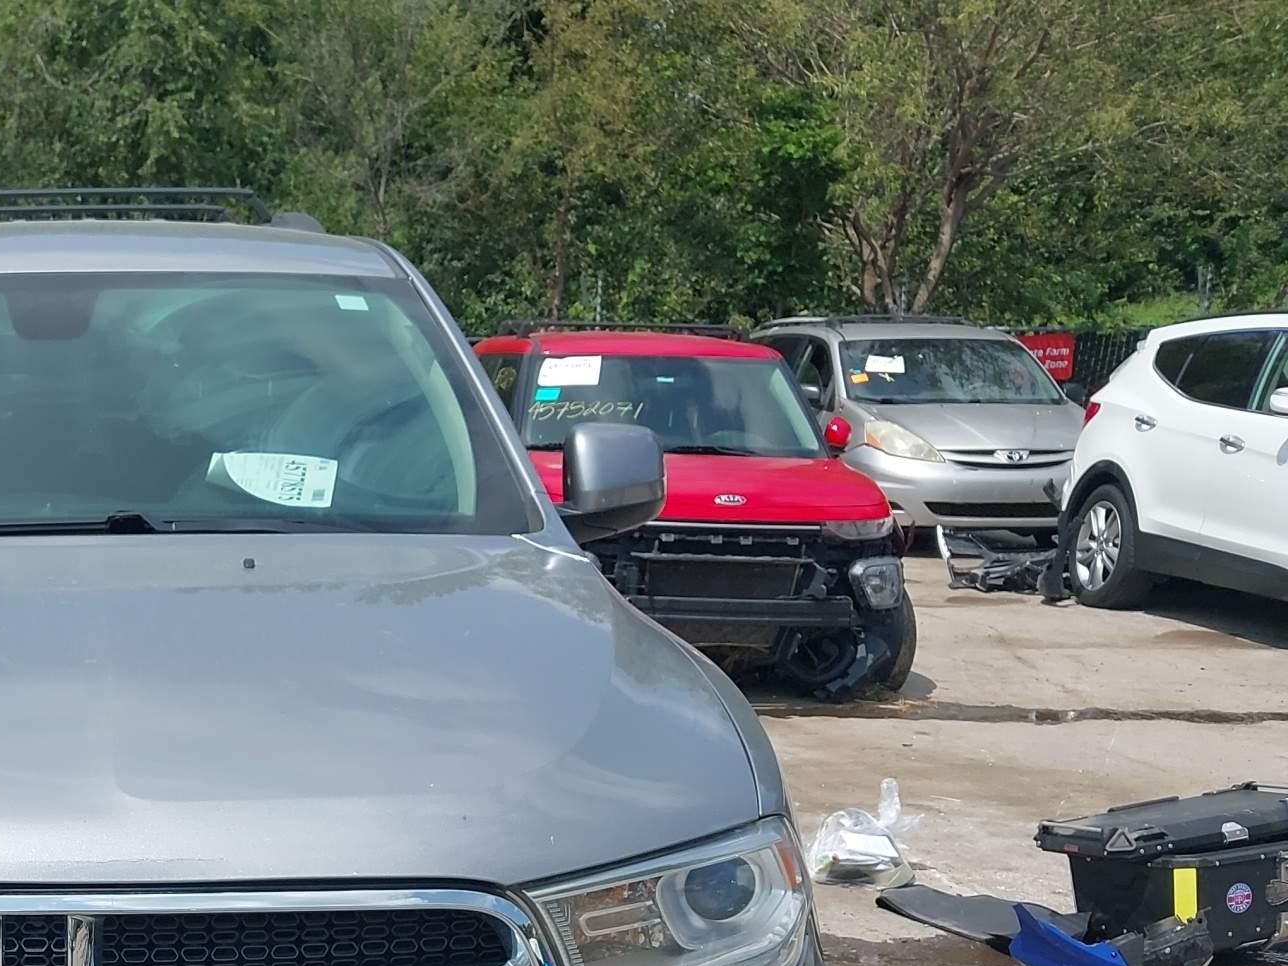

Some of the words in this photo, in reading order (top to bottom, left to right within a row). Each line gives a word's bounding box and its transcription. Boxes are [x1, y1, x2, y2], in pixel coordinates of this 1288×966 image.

[1046, 347, 1070, 356] Farm
[1045, 360, 1068, 369] Zone
[528, 401, 643, 420] 45752071
